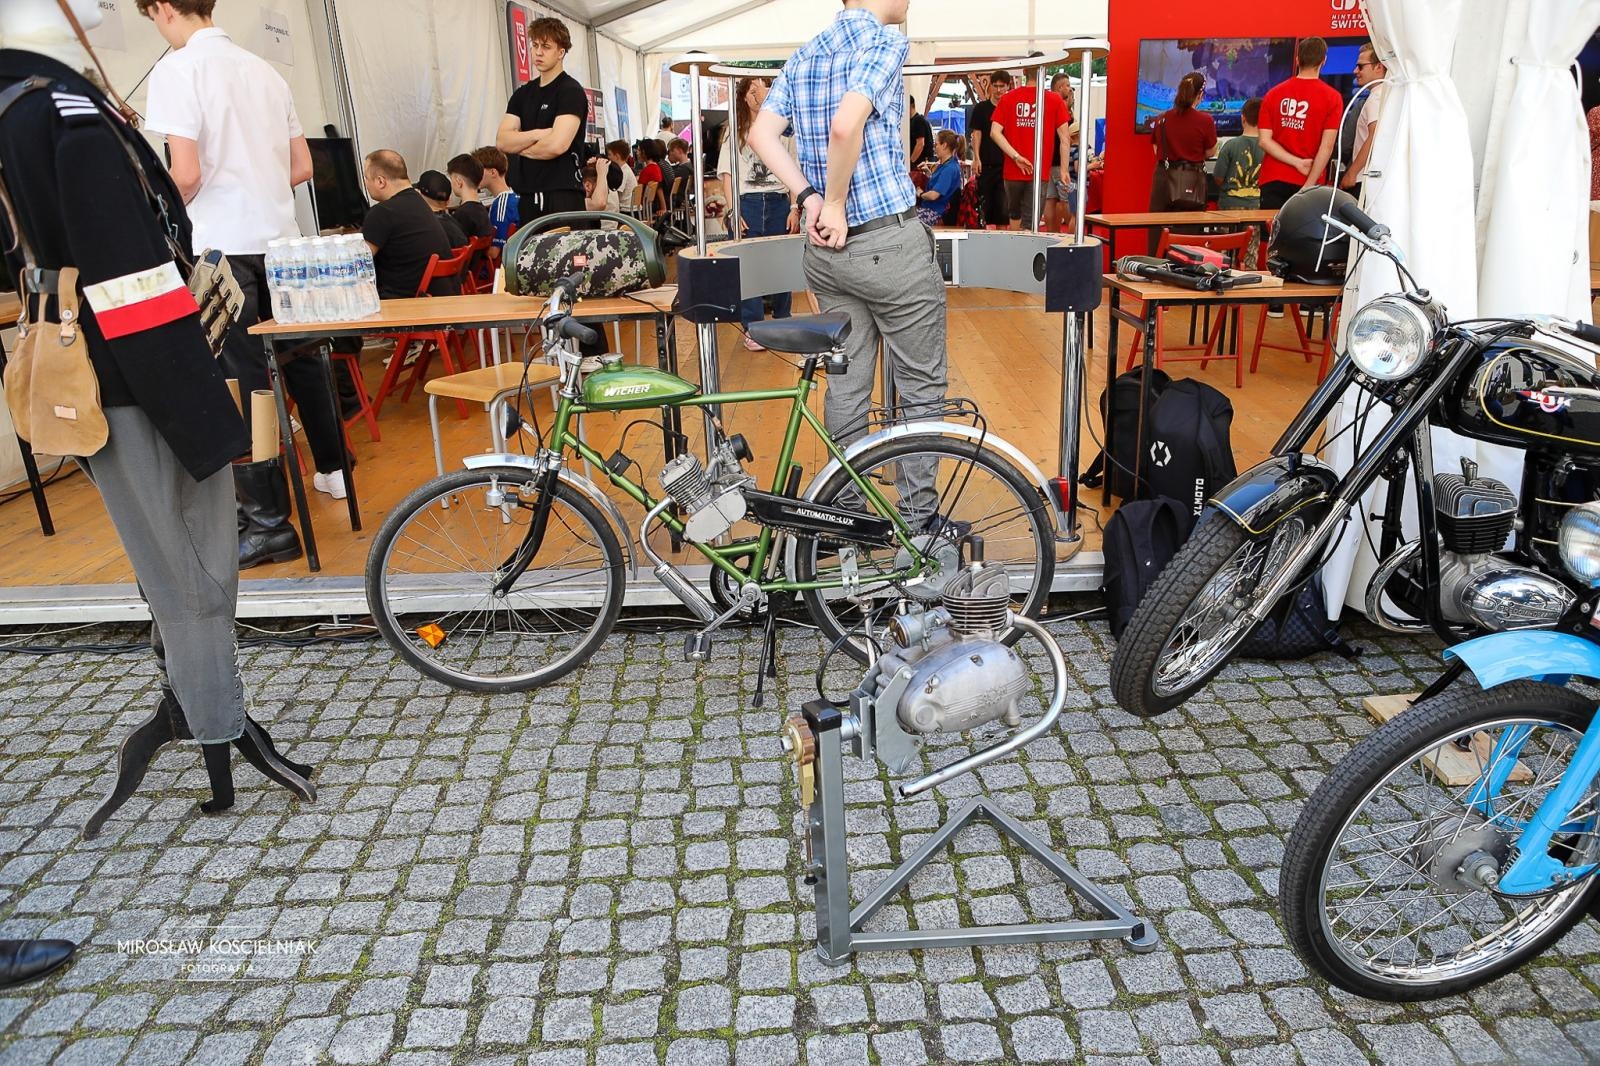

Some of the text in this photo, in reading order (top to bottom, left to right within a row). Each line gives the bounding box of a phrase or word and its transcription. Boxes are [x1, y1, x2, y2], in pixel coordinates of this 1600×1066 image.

[1331, 19, 1366, 29] SWITC
[604, 383, 652, 397] WICHER
[1193, 478, 1204, 516] XLMOTO
[795, 507, 855, 526] AUTOMATIC-LUX
